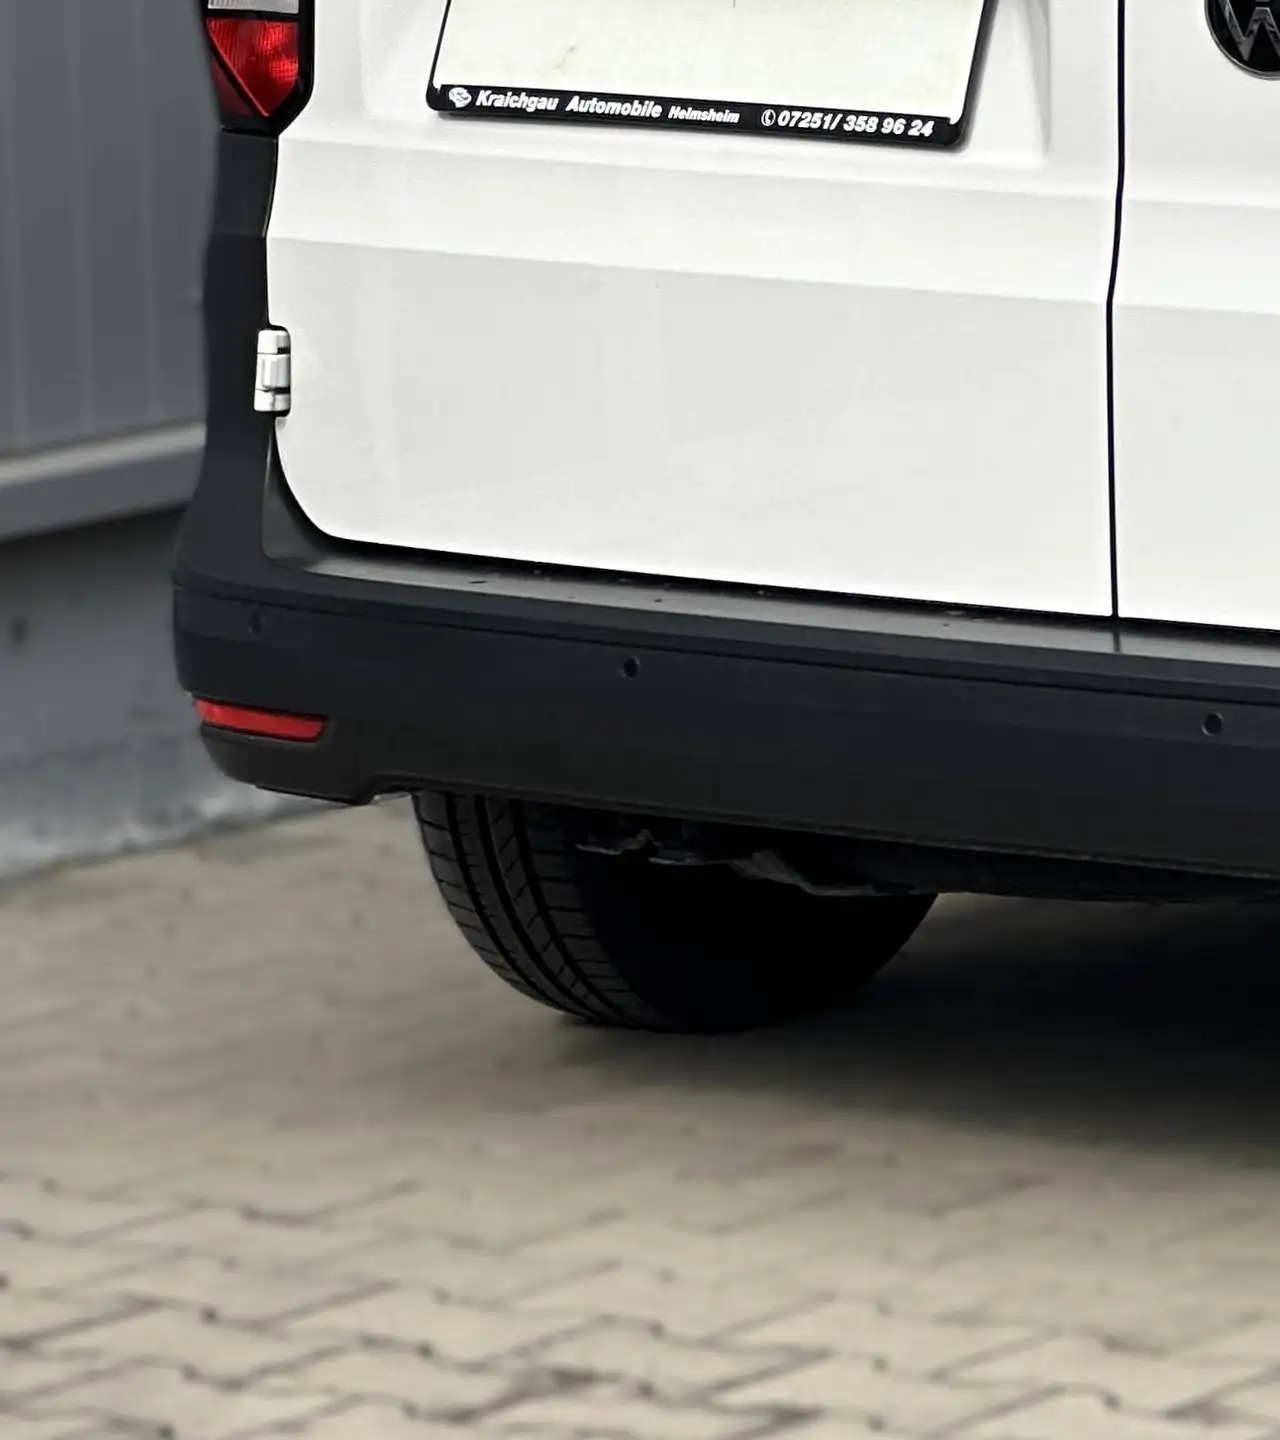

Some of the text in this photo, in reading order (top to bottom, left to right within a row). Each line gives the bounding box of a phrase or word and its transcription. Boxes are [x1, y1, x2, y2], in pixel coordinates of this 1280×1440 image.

[475, 90, 560, 113] Kraichgau
[565, 95, 663, 118] Automobile
[777, 110, 843, 131] 07251/
[842, 114, 879, 133] 358
[880, 117, 907, 135] 96
[907, 119, 935, 137] 24
